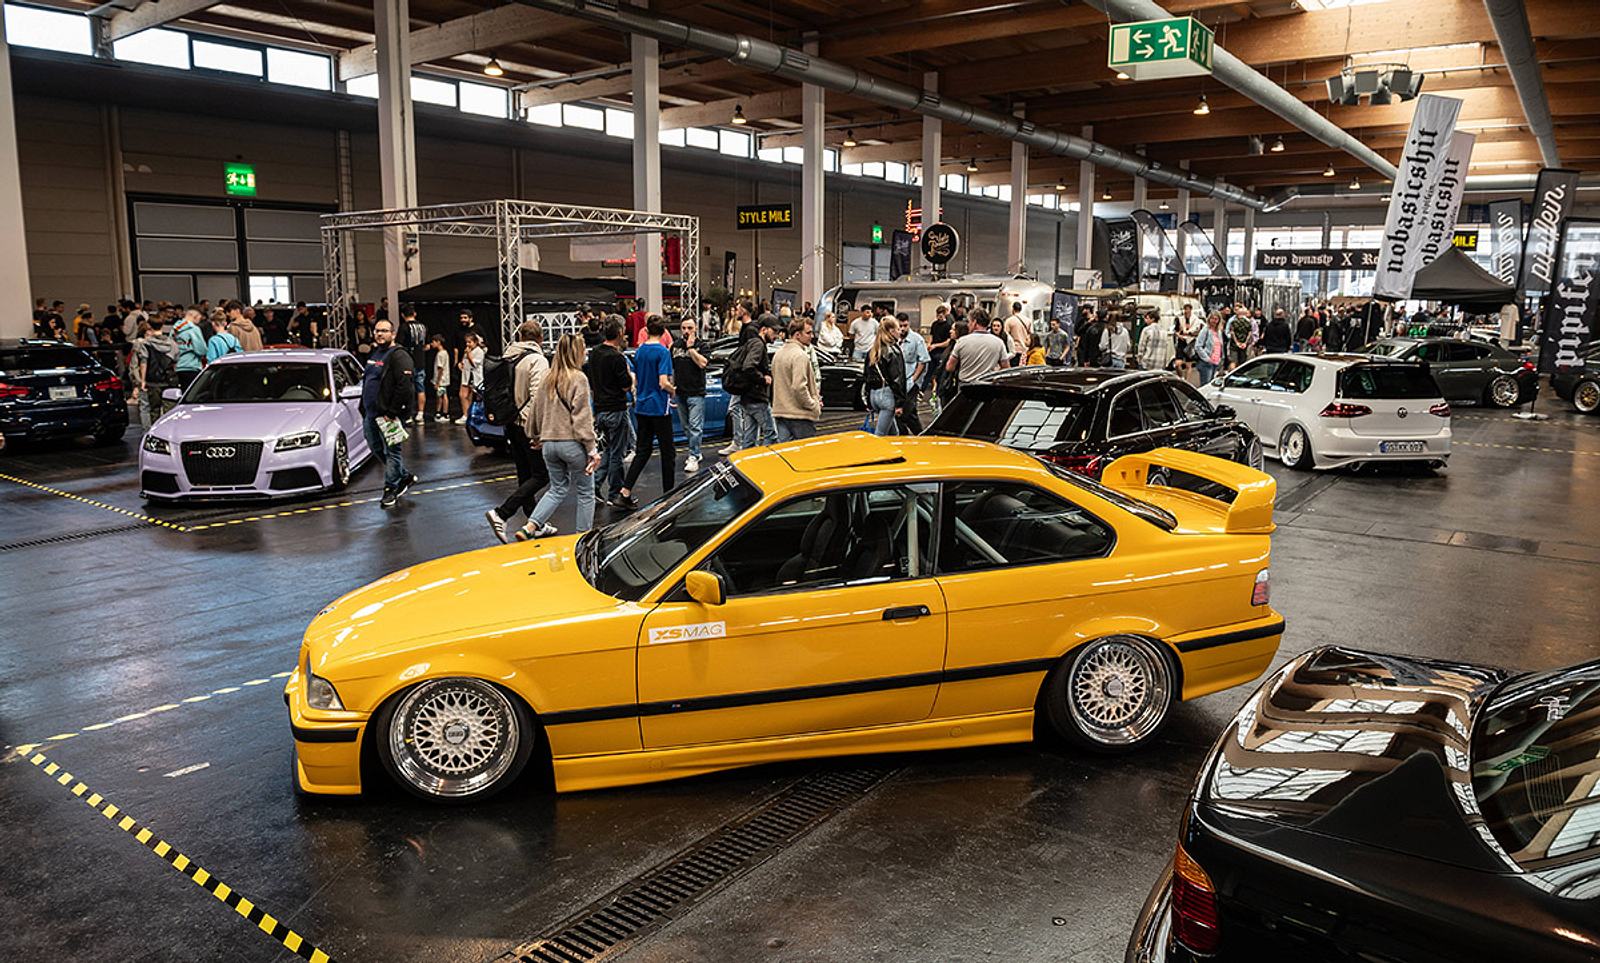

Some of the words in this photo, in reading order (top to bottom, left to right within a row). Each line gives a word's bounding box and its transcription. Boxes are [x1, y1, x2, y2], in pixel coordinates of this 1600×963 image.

[739, 211, 767, 224] STYLE
[768, 210, 791, 223] MILE
[1387, 128, 1438, 273] nobasicshit
[1421, 157, 1461, 265] obasicshit
[1263, 253, 1287, 266] deep
[1291, 253, 1333, 267] dynasty
[1341, 252, 1353, 266] X
